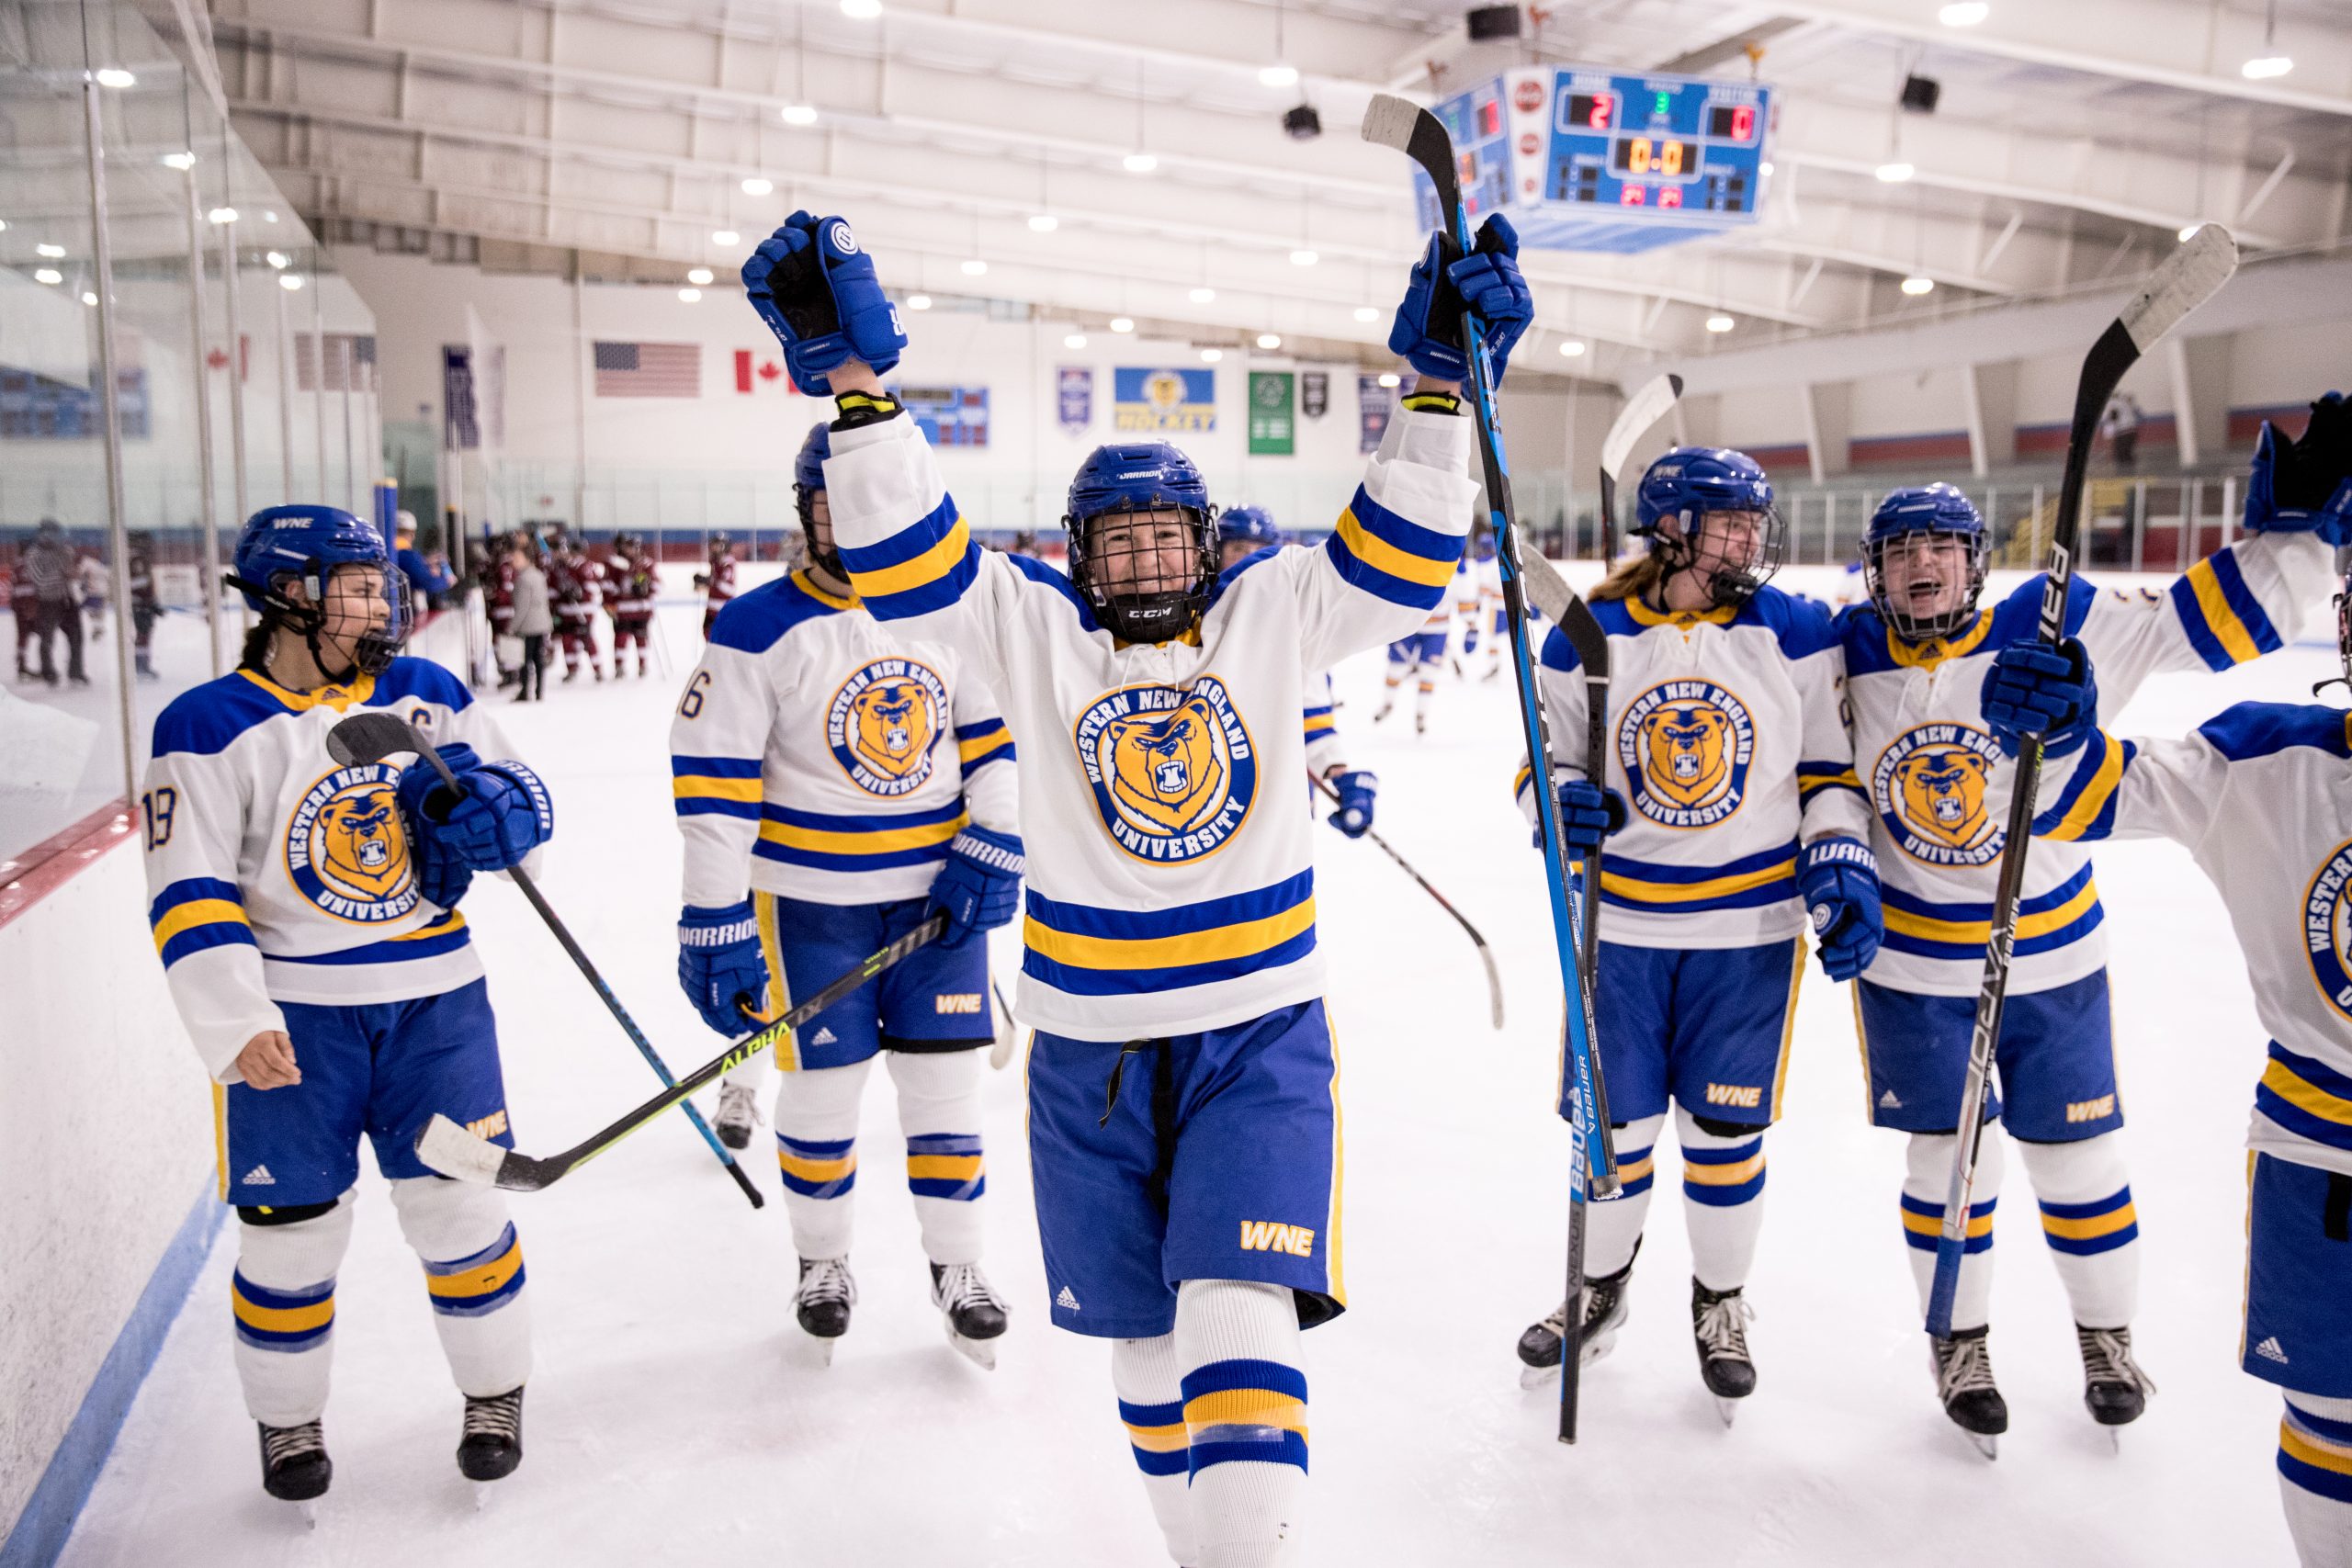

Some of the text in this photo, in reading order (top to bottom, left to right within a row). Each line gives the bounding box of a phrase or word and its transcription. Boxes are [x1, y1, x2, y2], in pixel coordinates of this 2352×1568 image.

[1589, 93, 1614, 130] 2
[1655, 90, 1670, 115] 3
[1731, 105, 1755, 142] 0
[1117, 469, 1162, 480] WARRIOR
[273, 517, 314, 530] WNE
[1128, 606, 1172, 619] CCM
[829, 659, 947, 749] WESTERN NEW ENGLAND
[1079, 694, 1131, 784] WESTERN
[1138, 689, 1182, 710] NEW
[1620, 690, 1663, 769] WESTERN
[1664, 682, 1707, 700] NEW
[1711, 689, 1753, 765] ENGLAND
[852, 754, 933, 795] UNIVERSITY
[1875, 739, 1914, 815] WESTERN
[1914, 725, 1958, 743] NEW
[141, 787, 176, 852] 19
[290, 764, 379, 871] WESTERN NEW
[1635, 786, 1742, 827] UNIVERSITY
[1111, 795, 1246, 859] UNIVERSITY
[1903, 830, 2007, 864] UNIVERSIT
[934, 993, 982, 1015] WNE
[720, 1021, 792, 1076] ALPHA
[1706, 1082, 1763, 1108] WNE
[2065, 1092, 2115, 1123] WNE
[243, 1177, 276, 1185] adidas
[1240, 1220, 1315, 1258] WNE
[1057, 1297, 1080, 1311] adidas
[2256, 1346, 2289, 1364] adidas
